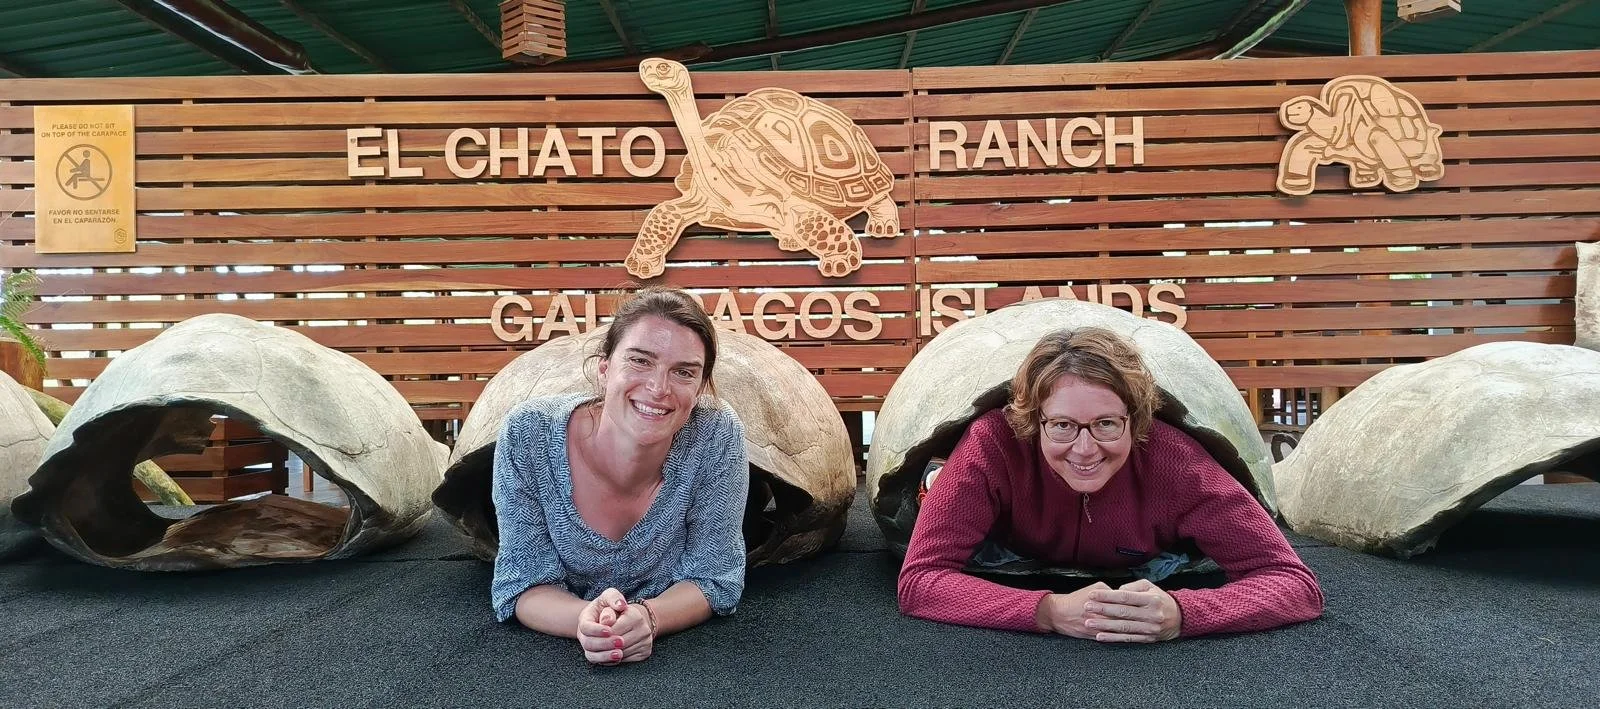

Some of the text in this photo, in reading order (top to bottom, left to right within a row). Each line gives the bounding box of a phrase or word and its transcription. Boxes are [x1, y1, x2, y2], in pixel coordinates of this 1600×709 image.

[346, 116, 1145, 179] EL CHATO RANCH
[85, 208, 120, 216] SENTARSE
[490, 291, 883, 342] GALAGOS
